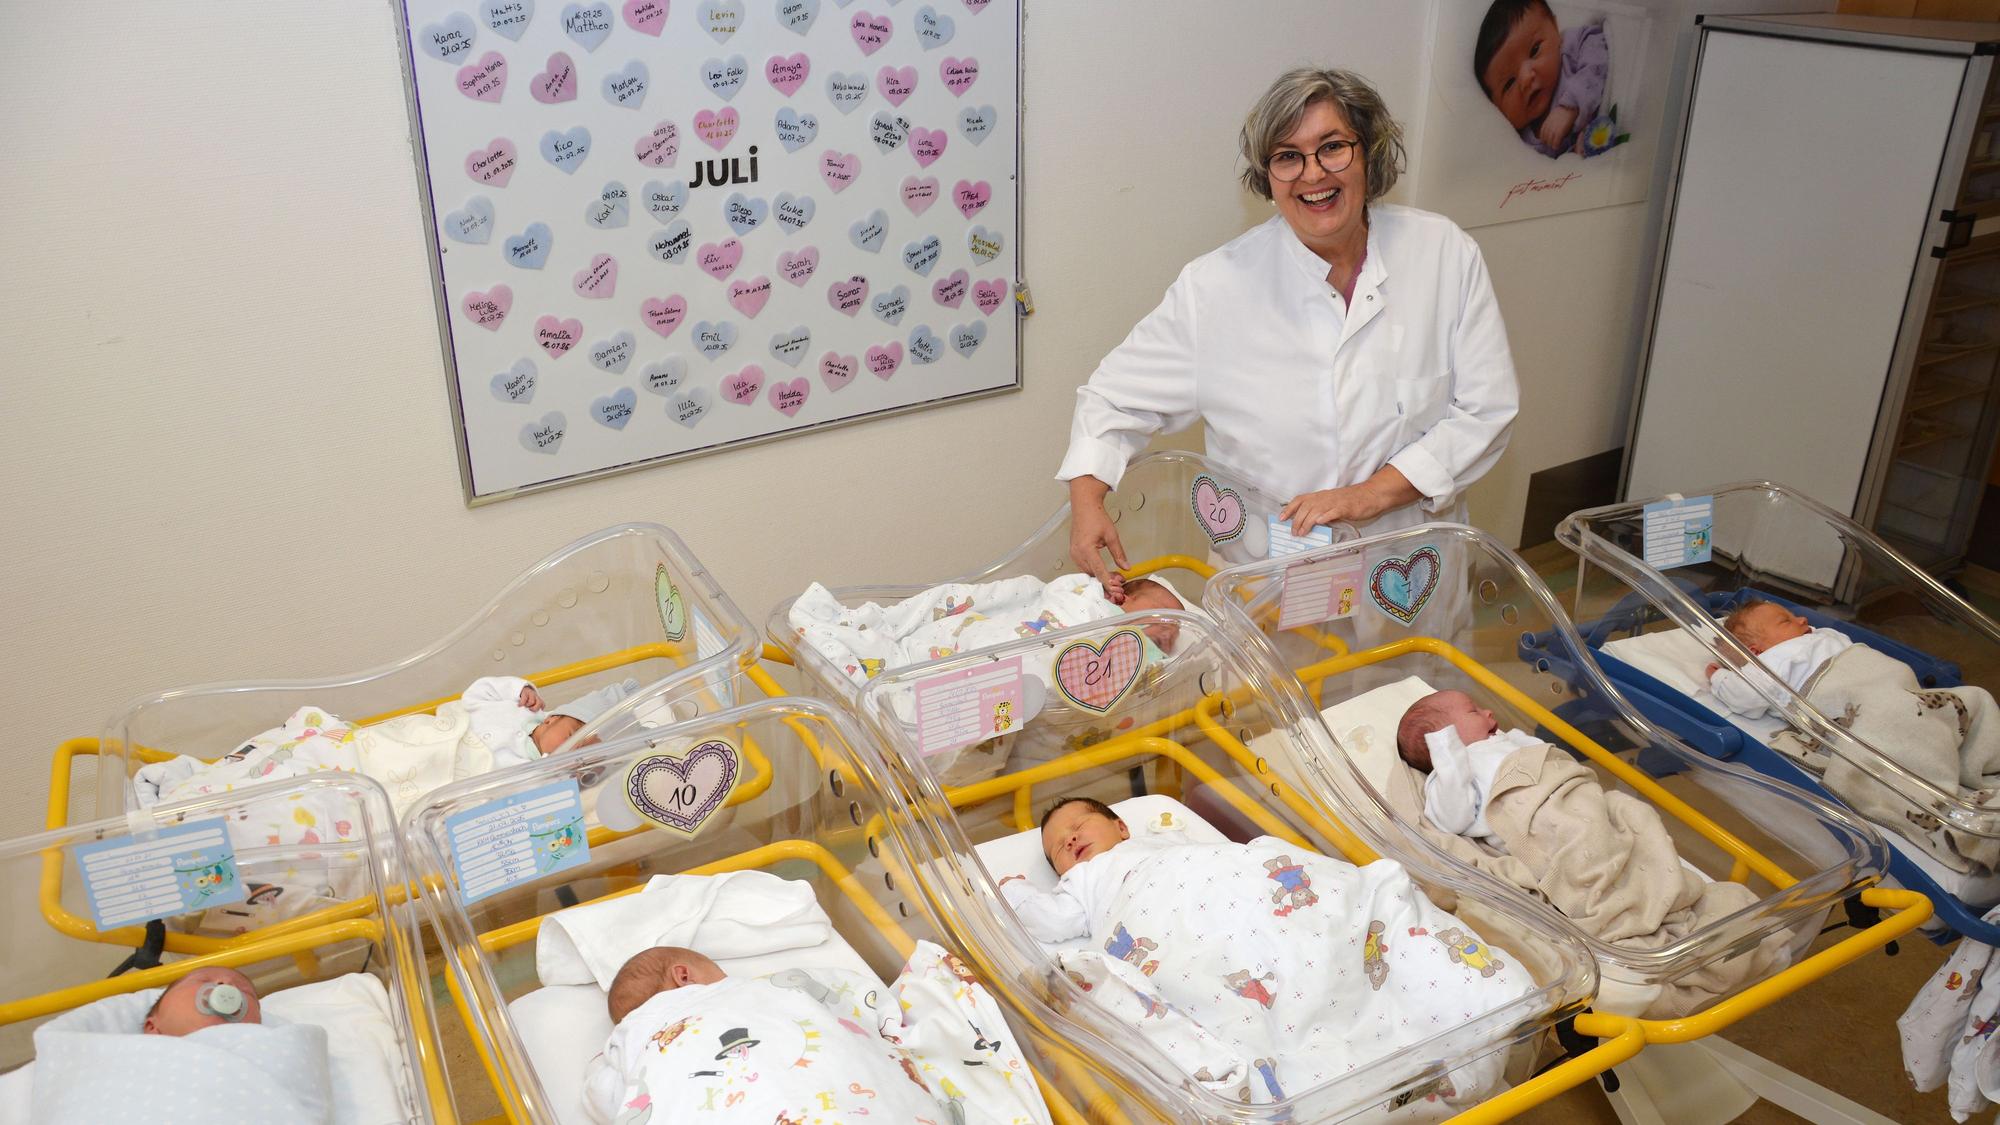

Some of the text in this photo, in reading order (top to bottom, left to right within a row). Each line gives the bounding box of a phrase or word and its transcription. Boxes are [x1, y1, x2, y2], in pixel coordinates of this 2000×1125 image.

[710, 10, 735, 20] Levin
[772, 63, 802, 76] Amaya
[462, 72, 487, 90] Sophia
[553, 140, 573, 152] Nico
[472, 150, 505, 172] Charlotte
[780, 201, 804, 217] Luke
[785, 258, 812, 272] Sarah
[875, 296, 905, 312] Samuel
[602, 402, 625, 414] Lenny
[1209, 503, 1227, 524] 20
[664, 598, 675, 624] 18
[668, 784, 697, 811] 10
